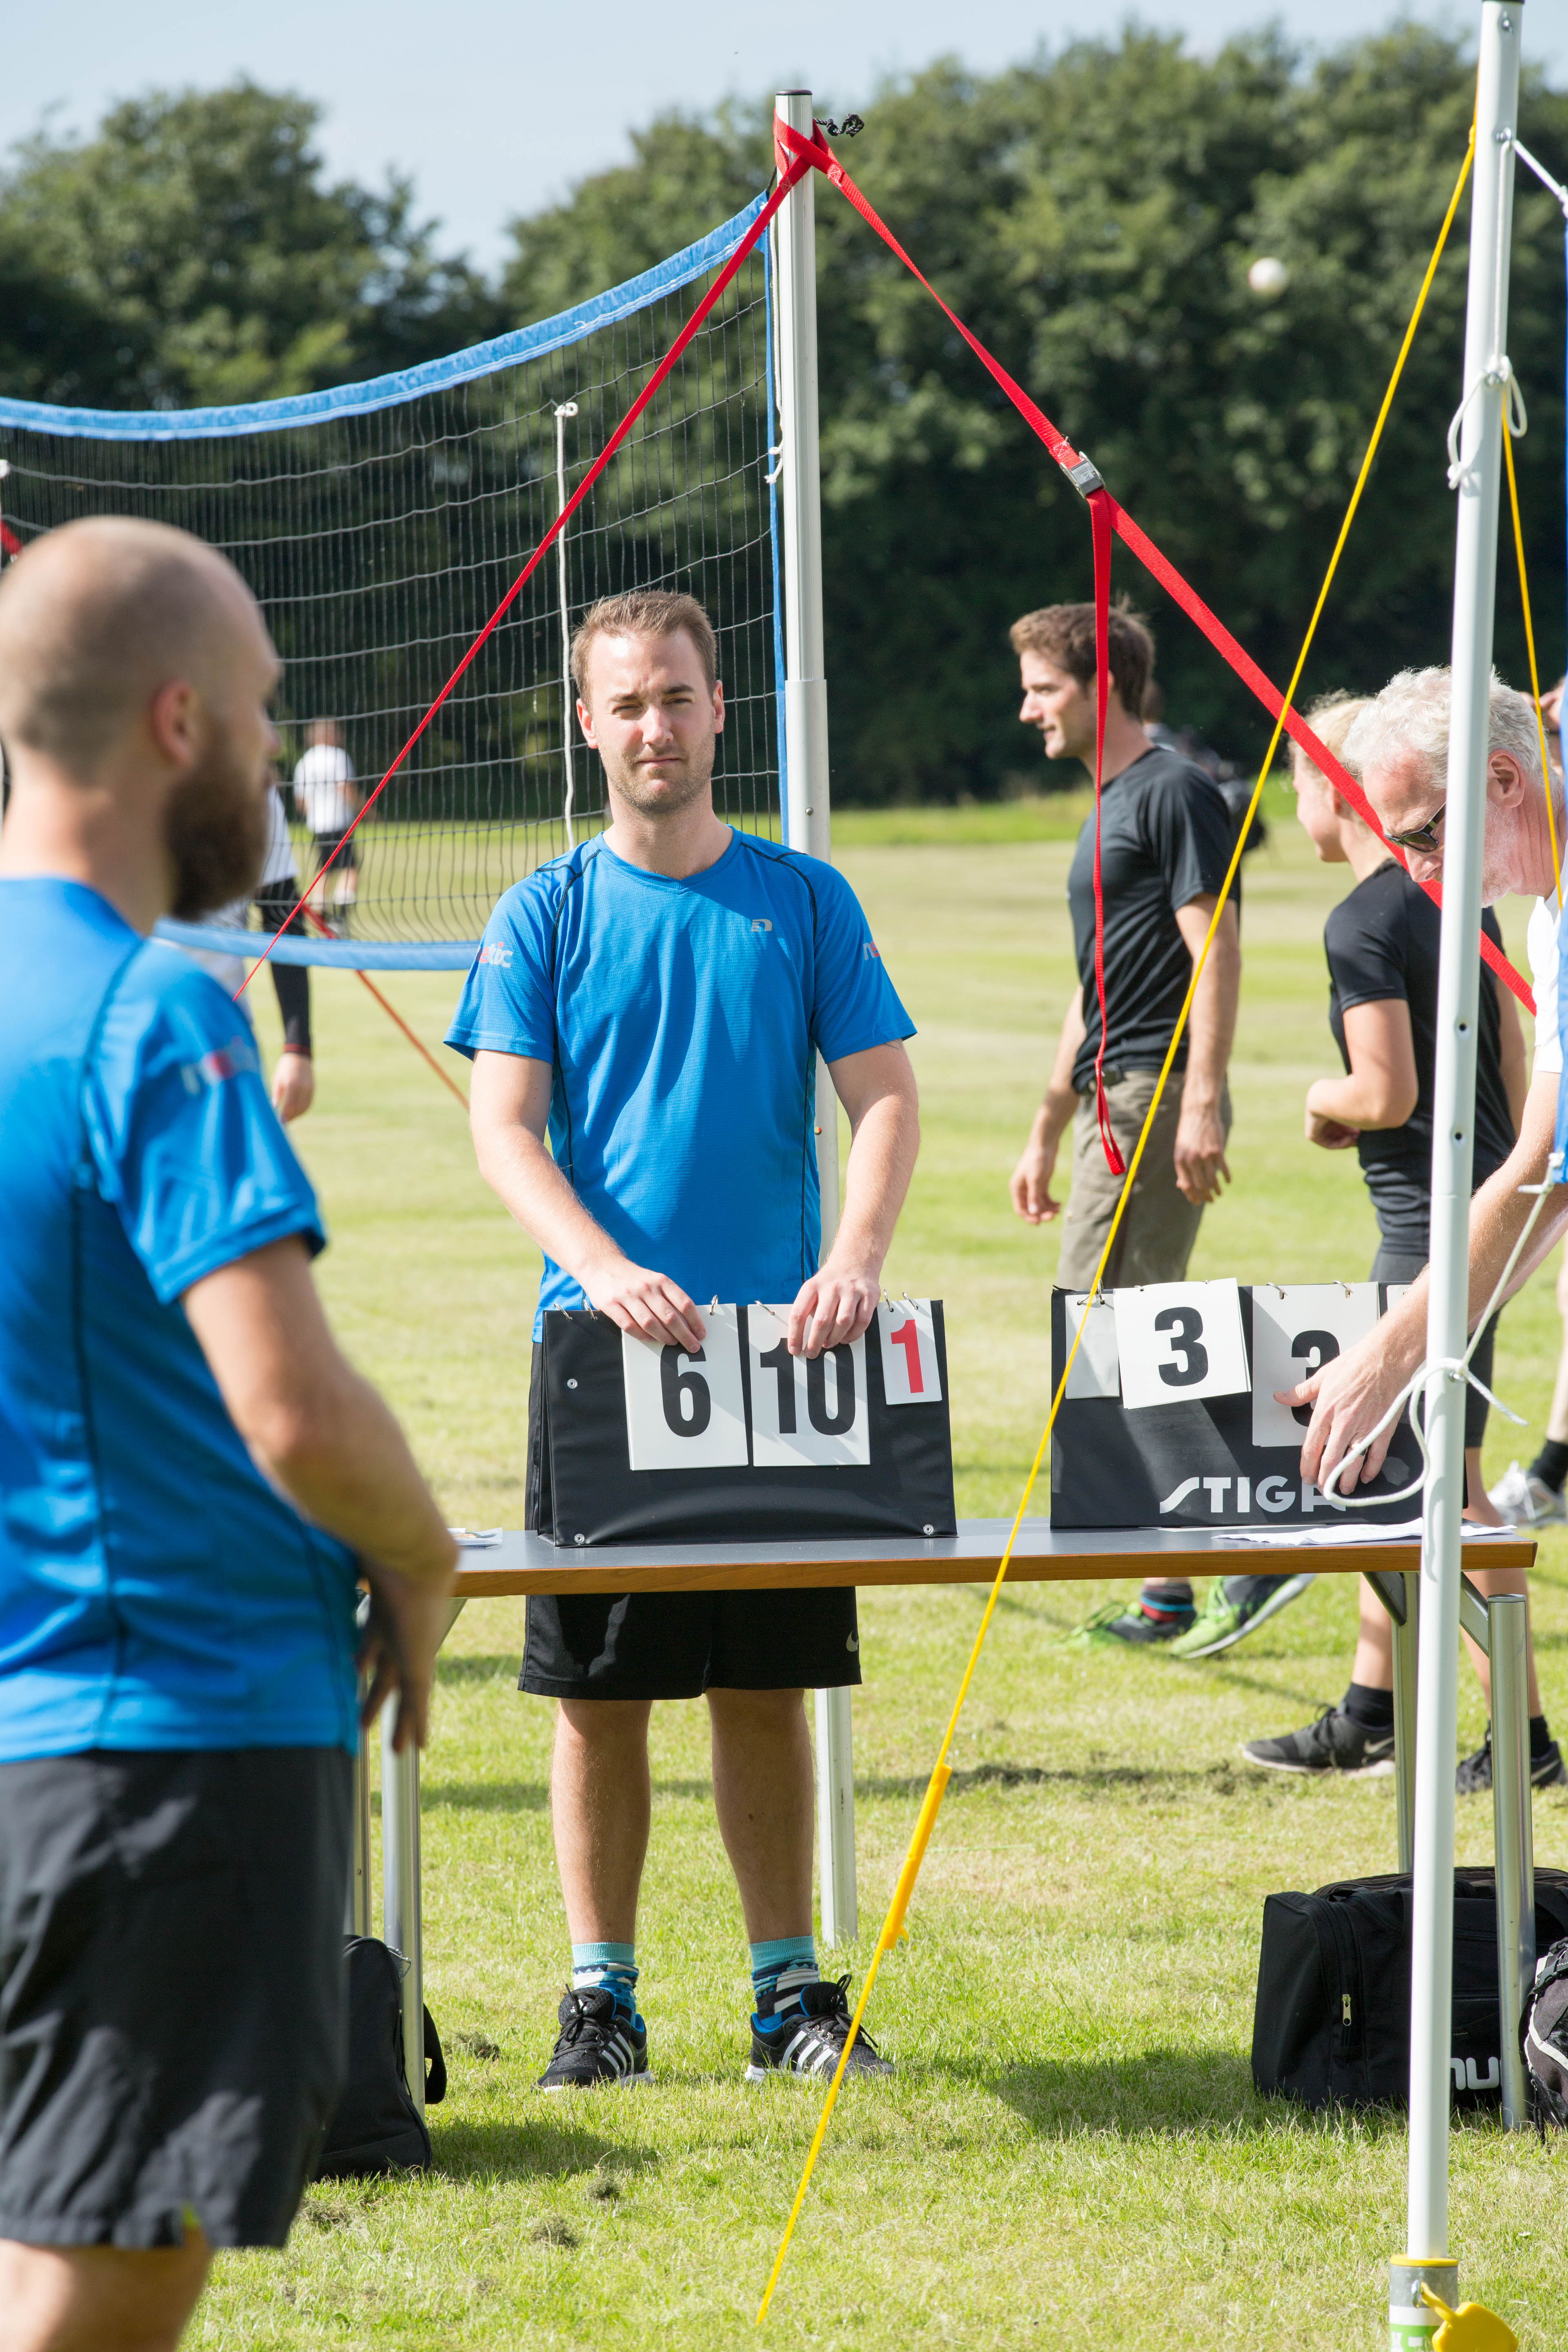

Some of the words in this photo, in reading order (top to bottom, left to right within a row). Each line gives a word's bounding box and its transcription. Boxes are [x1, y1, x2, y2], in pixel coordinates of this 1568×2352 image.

[478, 941, 514, 968] etic
[660, 1343, 711, 1438] 6
[760, 1337, 856, 1436] 10
[891, 1319, 924, 1394] 1
[1154, 1306, 1209, 1387] 3
